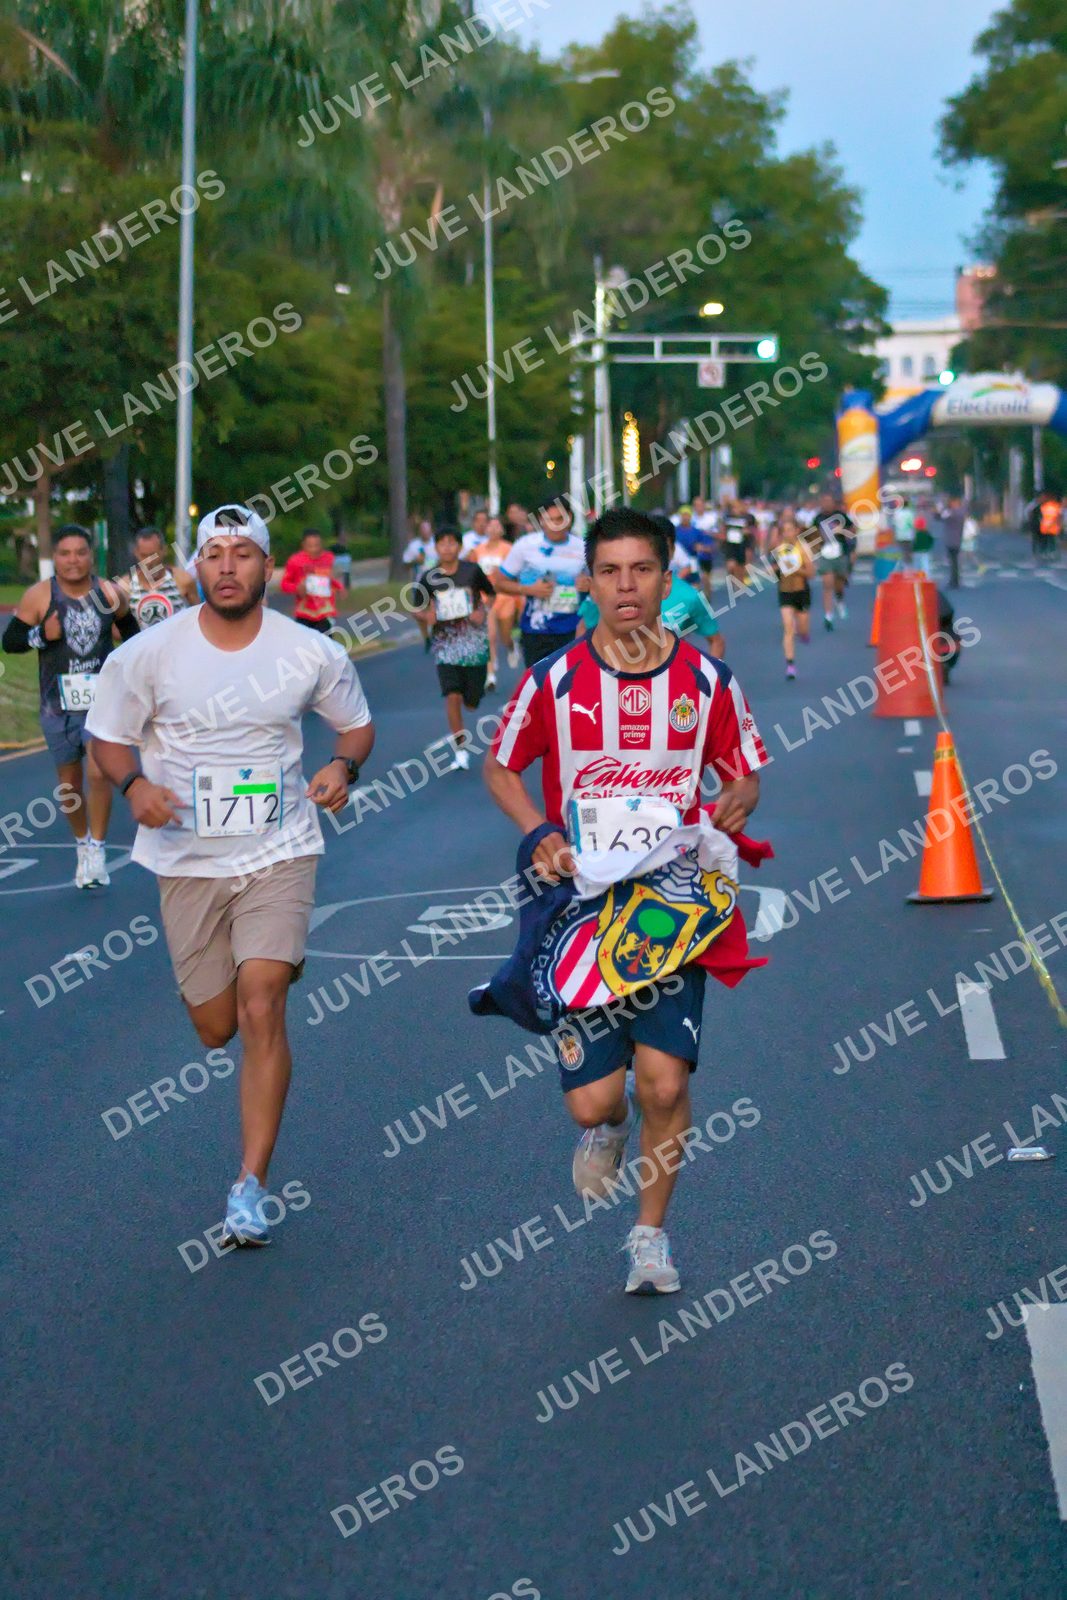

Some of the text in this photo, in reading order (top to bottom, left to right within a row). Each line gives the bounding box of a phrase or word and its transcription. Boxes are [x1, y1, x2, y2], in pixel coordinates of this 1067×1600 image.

[71, 689, 95, 706] 85
[623, 689, 647, 712] MG
[623, 731, 646, 739] prime
[573, 755, 693, 790] Caliente
[202, 794, 279, 827] 1712
